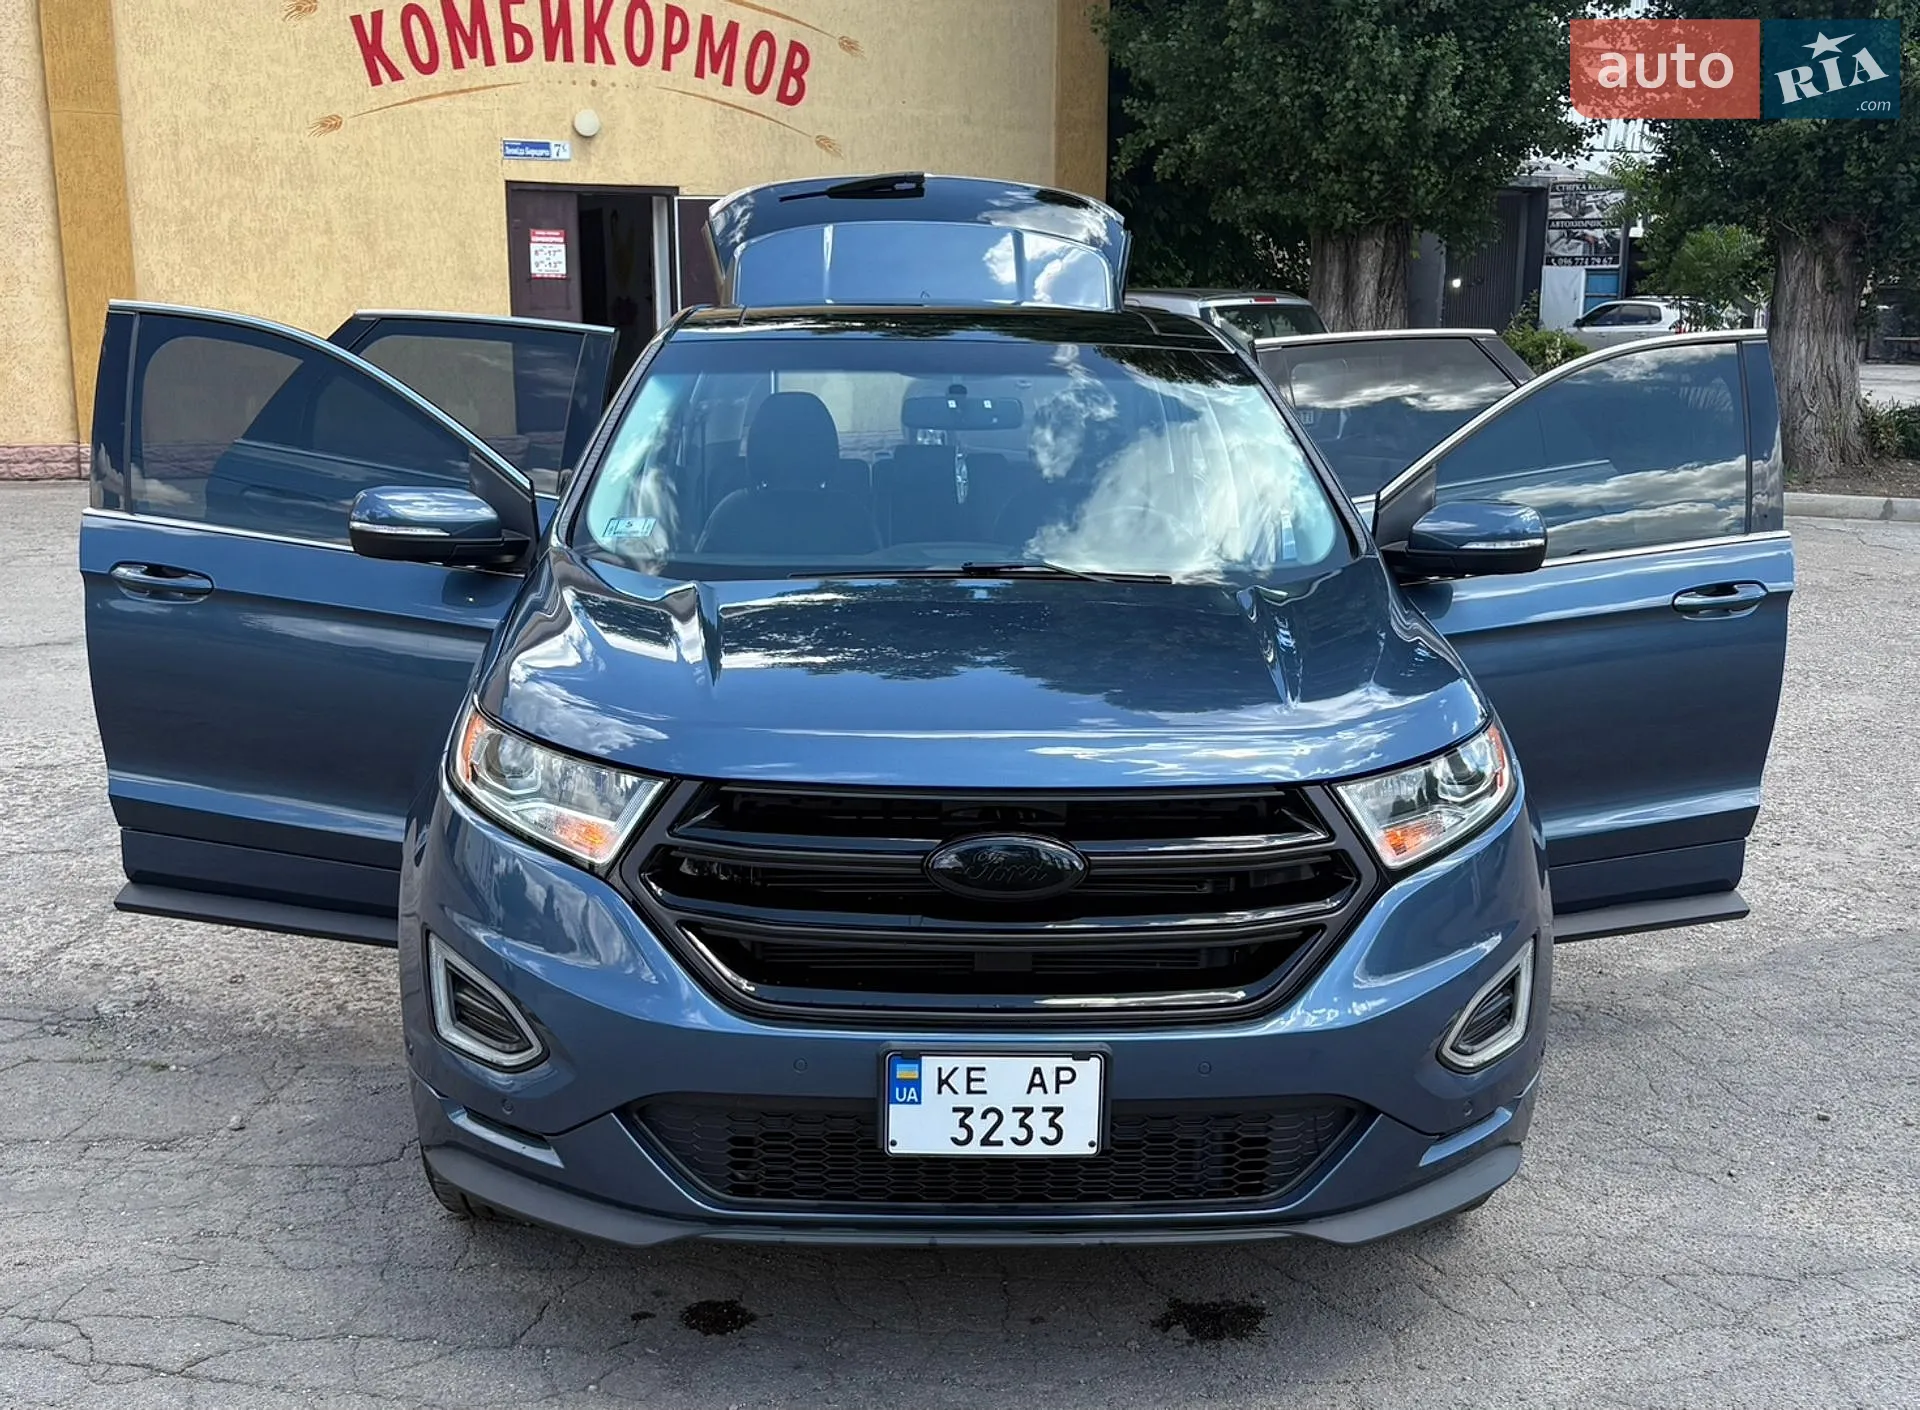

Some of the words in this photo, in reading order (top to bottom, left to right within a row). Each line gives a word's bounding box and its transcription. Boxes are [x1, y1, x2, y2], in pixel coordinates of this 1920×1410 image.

[350, 0, 811, 107] КОМБИКОРМОВ
[966, 849, 1048, 883] Ford
[895, 1087, 918, 1103] UA
[937, 1066, 988, 1095] KE
[1026, 1066, 1077, 1095] AP
[950, 1106, 1064, 1147] 3233
